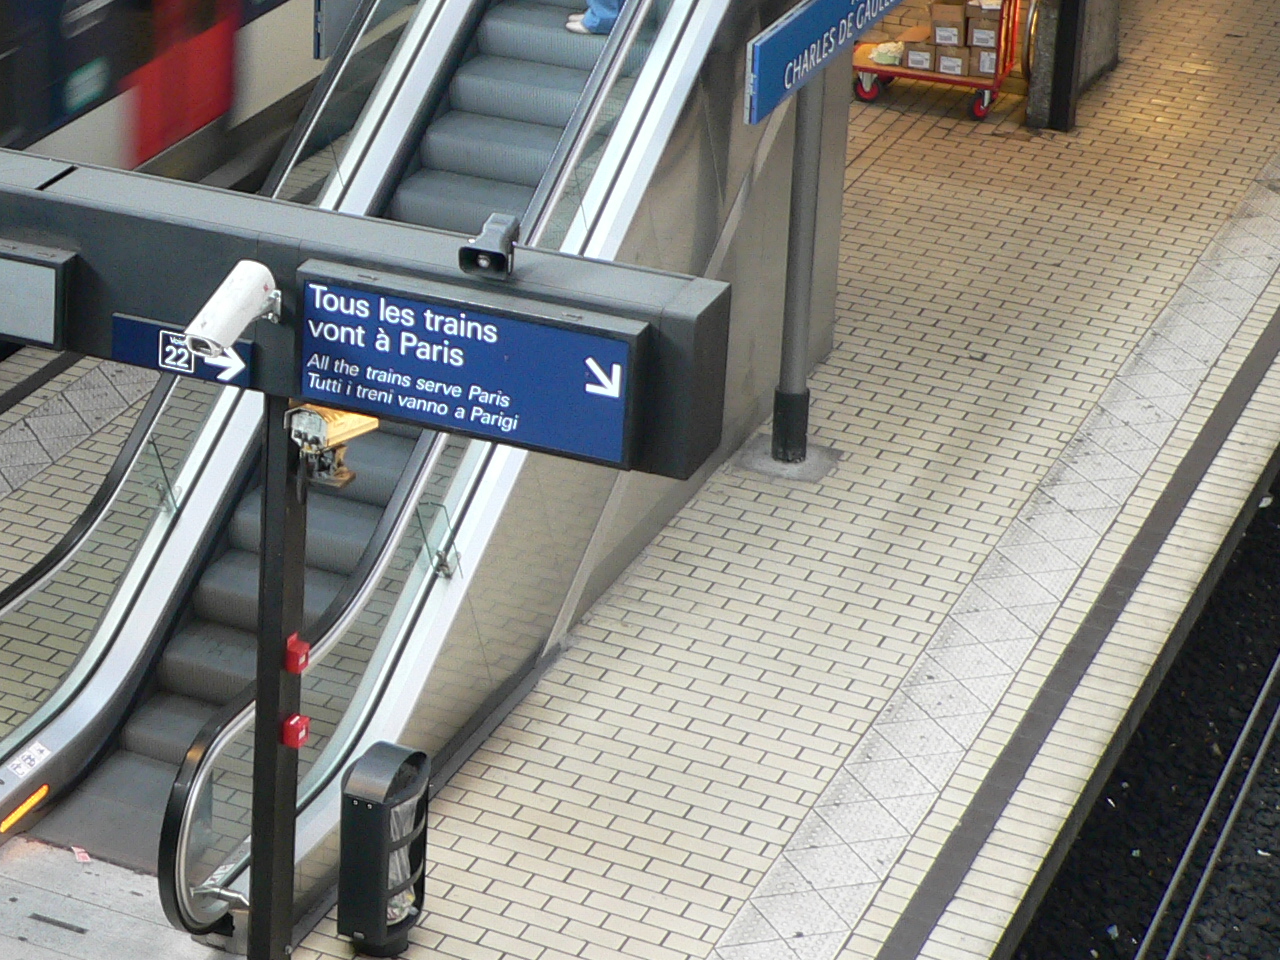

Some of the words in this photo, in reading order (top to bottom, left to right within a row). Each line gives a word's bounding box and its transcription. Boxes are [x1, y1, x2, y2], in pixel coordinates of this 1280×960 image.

[784, 26, 836, 89] CHARLES
[838, 11, 854, 45] DE
[308, 283, 370, 319] Tous
[379, 297, 415, 327] les
[423, 309, 498, 343] trains
[165, 345, 189, 368] 22
[308, 319, 365, 347] vont
[375, 328, 390, 352] à
[400, 331, 464, 367] Paris
[306, 353, 328, 371] All
[334, 357, 359, 377] the
[366, 366, 411, 388] trains
[415, 377, 462, 398] serve
[468, 385, 511, 408] Paris
[307, 372, 342, 394] Tutti
[345, 380, 352, 396] i
[356, 383, 393, 404] treni
[398, 395, 448, 416] vanno
[454, 406, 465, 419] a
[470, 408, 519, 433] Parigi
